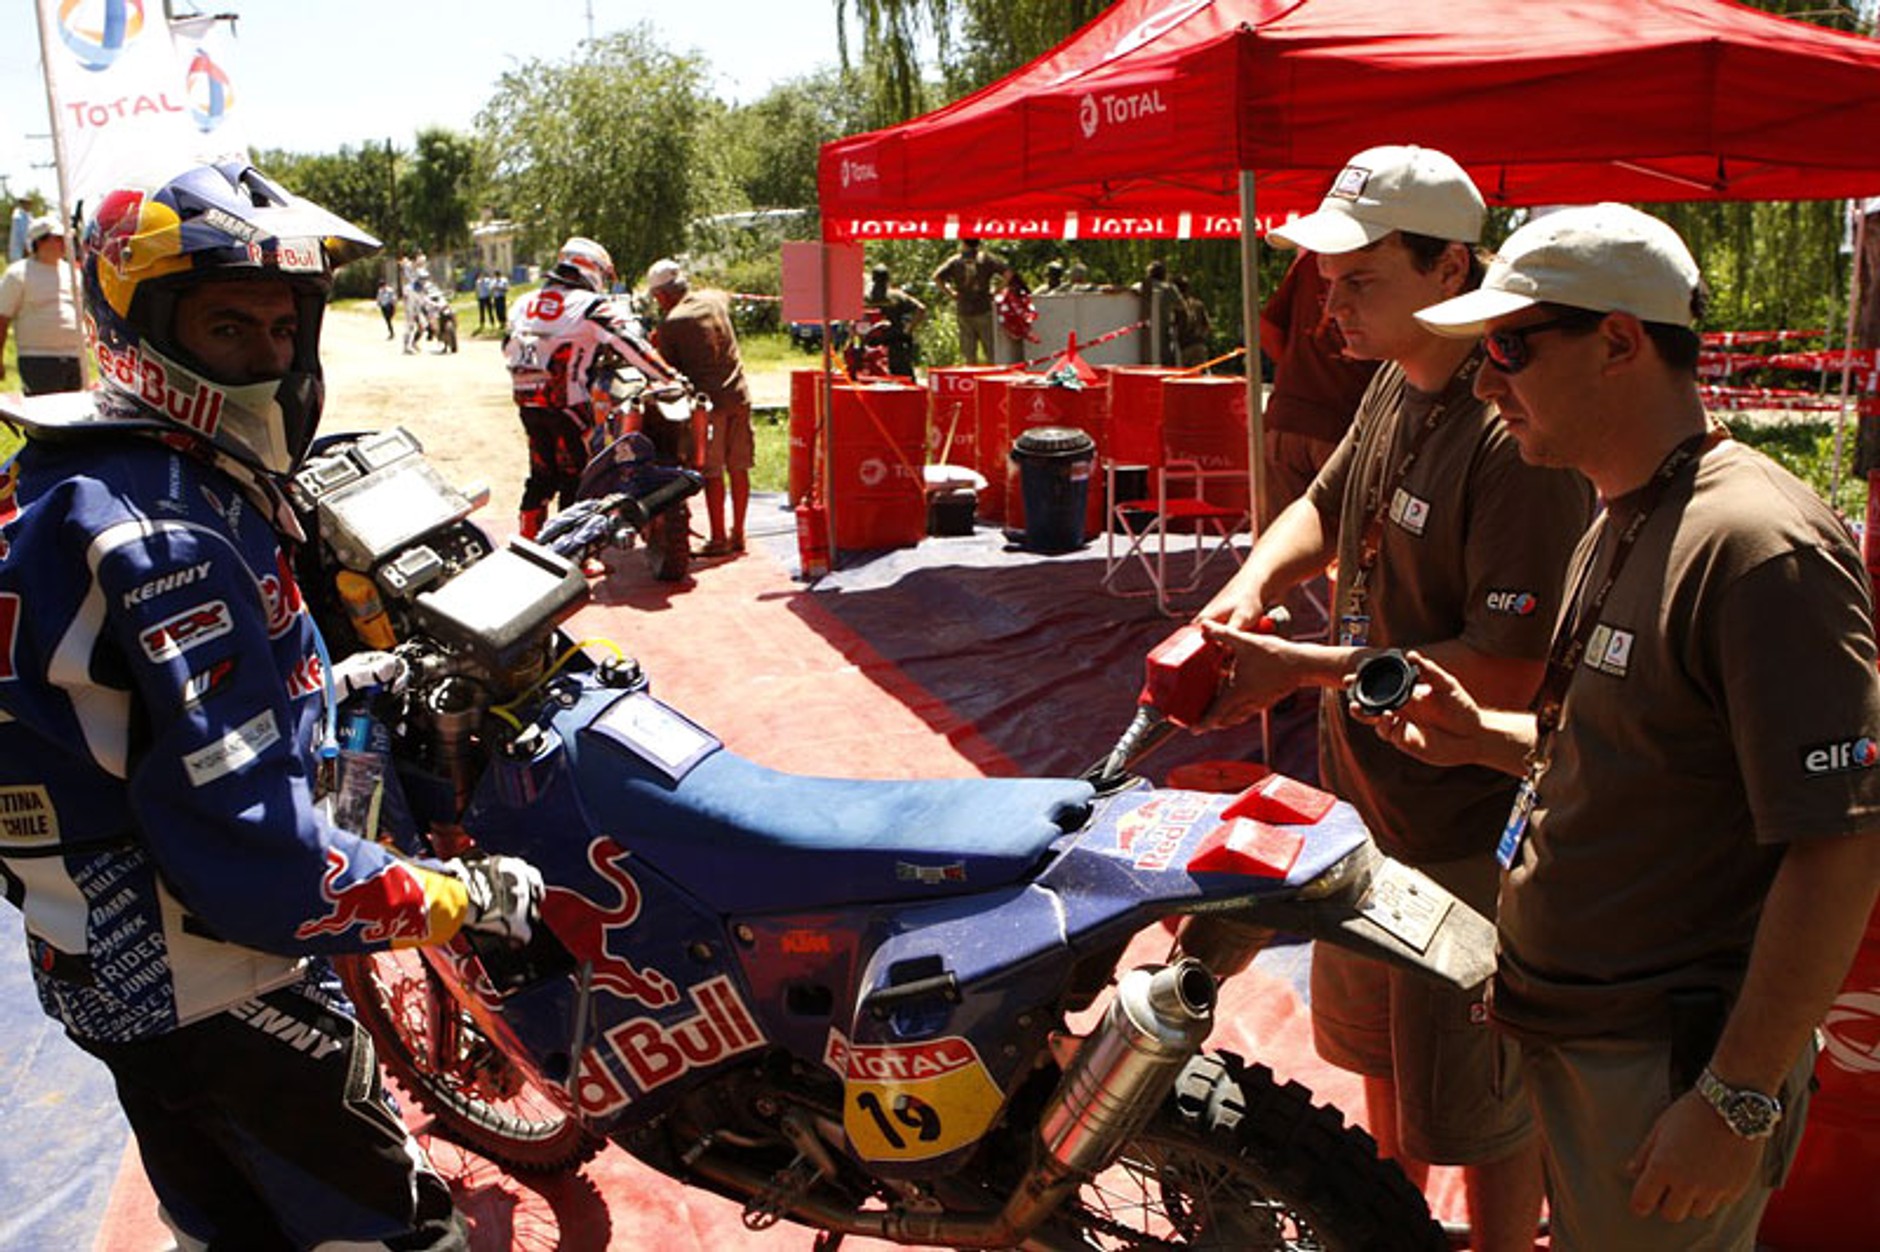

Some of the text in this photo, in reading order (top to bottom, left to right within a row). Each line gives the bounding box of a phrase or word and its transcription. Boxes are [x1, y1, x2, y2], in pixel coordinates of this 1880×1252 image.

[67, 93, 184, 129] TOTAL
[1102, 88, 1167, 125] TOTAL
[139, 356, 225, 436] Bull
[123, 561, 213, 610] KENNY
[1486, 591, 1518, 611] elf
[1804, 742, 1852, 773] elf
[101, 931, 164, 983] RIDER
[120, 956, 169, 1000] JUNIO
[228, 999, 342, 1060] ENNY
[604, 974, 769, 1092] Bull
[850, 1050, 970, 1078] TOTAL
[856, 1091, 942, 1149] 19
